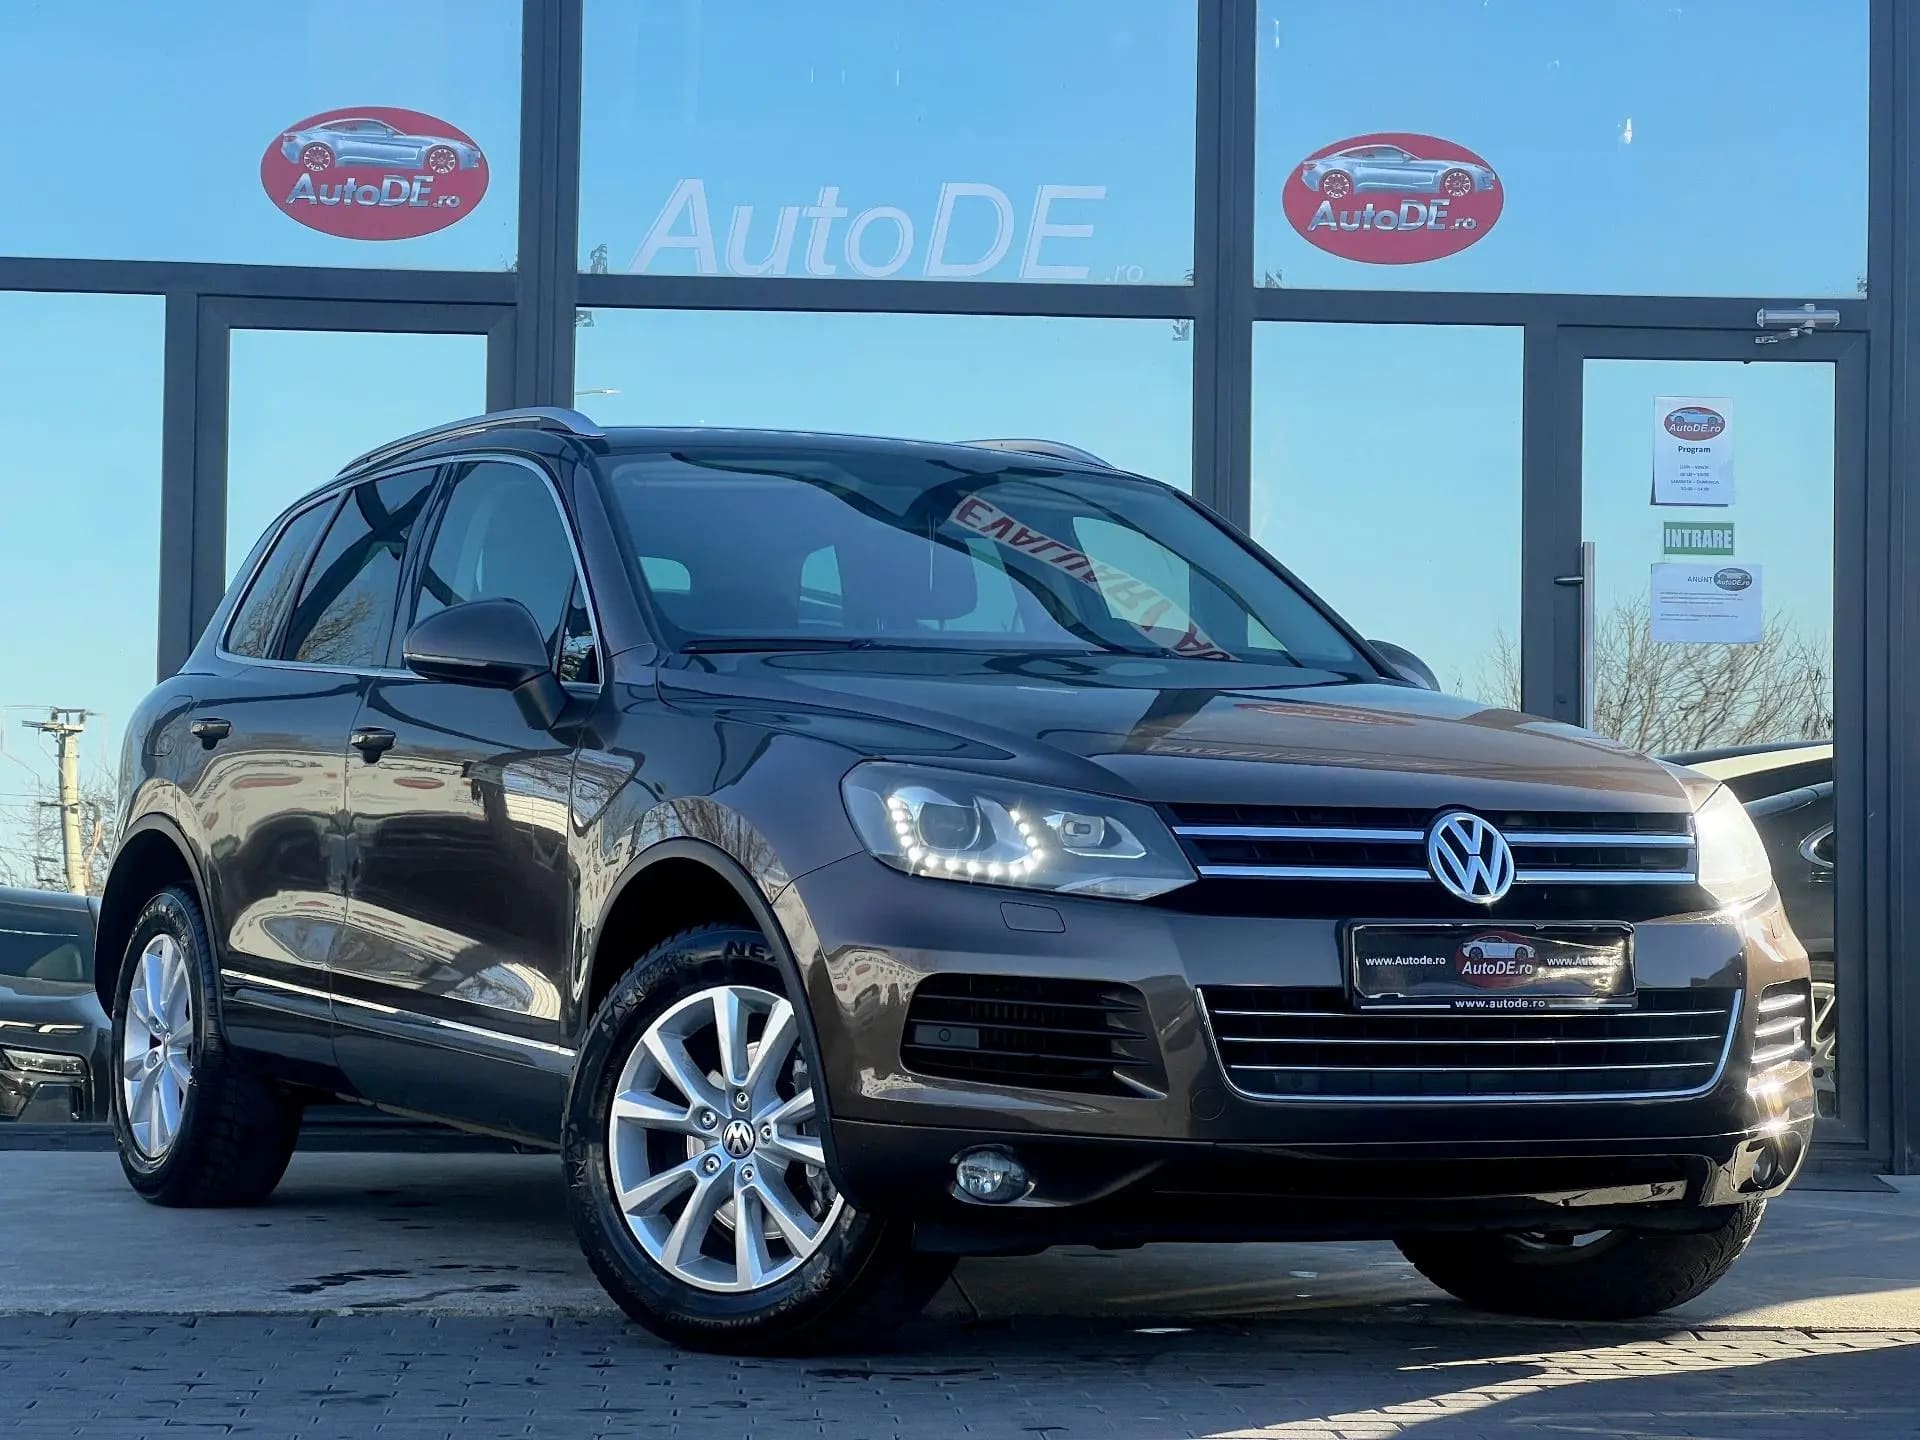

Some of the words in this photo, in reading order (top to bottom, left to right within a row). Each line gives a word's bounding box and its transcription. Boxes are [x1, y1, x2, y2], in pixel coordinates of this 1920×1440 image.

[1668, 423, 1721, 433] AutoDE.ro
[1678, 445, 1711, 454] Program
[1665, 528, 1732, 549] INTRARE
[1429, 813, 1513, 902] VW
[1365, 954, 1446, 966] www.Autode.ro
[1461, 960, 1534, 976] AutoDE.ro
[1455, 998, 1546, 1009] www.autode.ro
